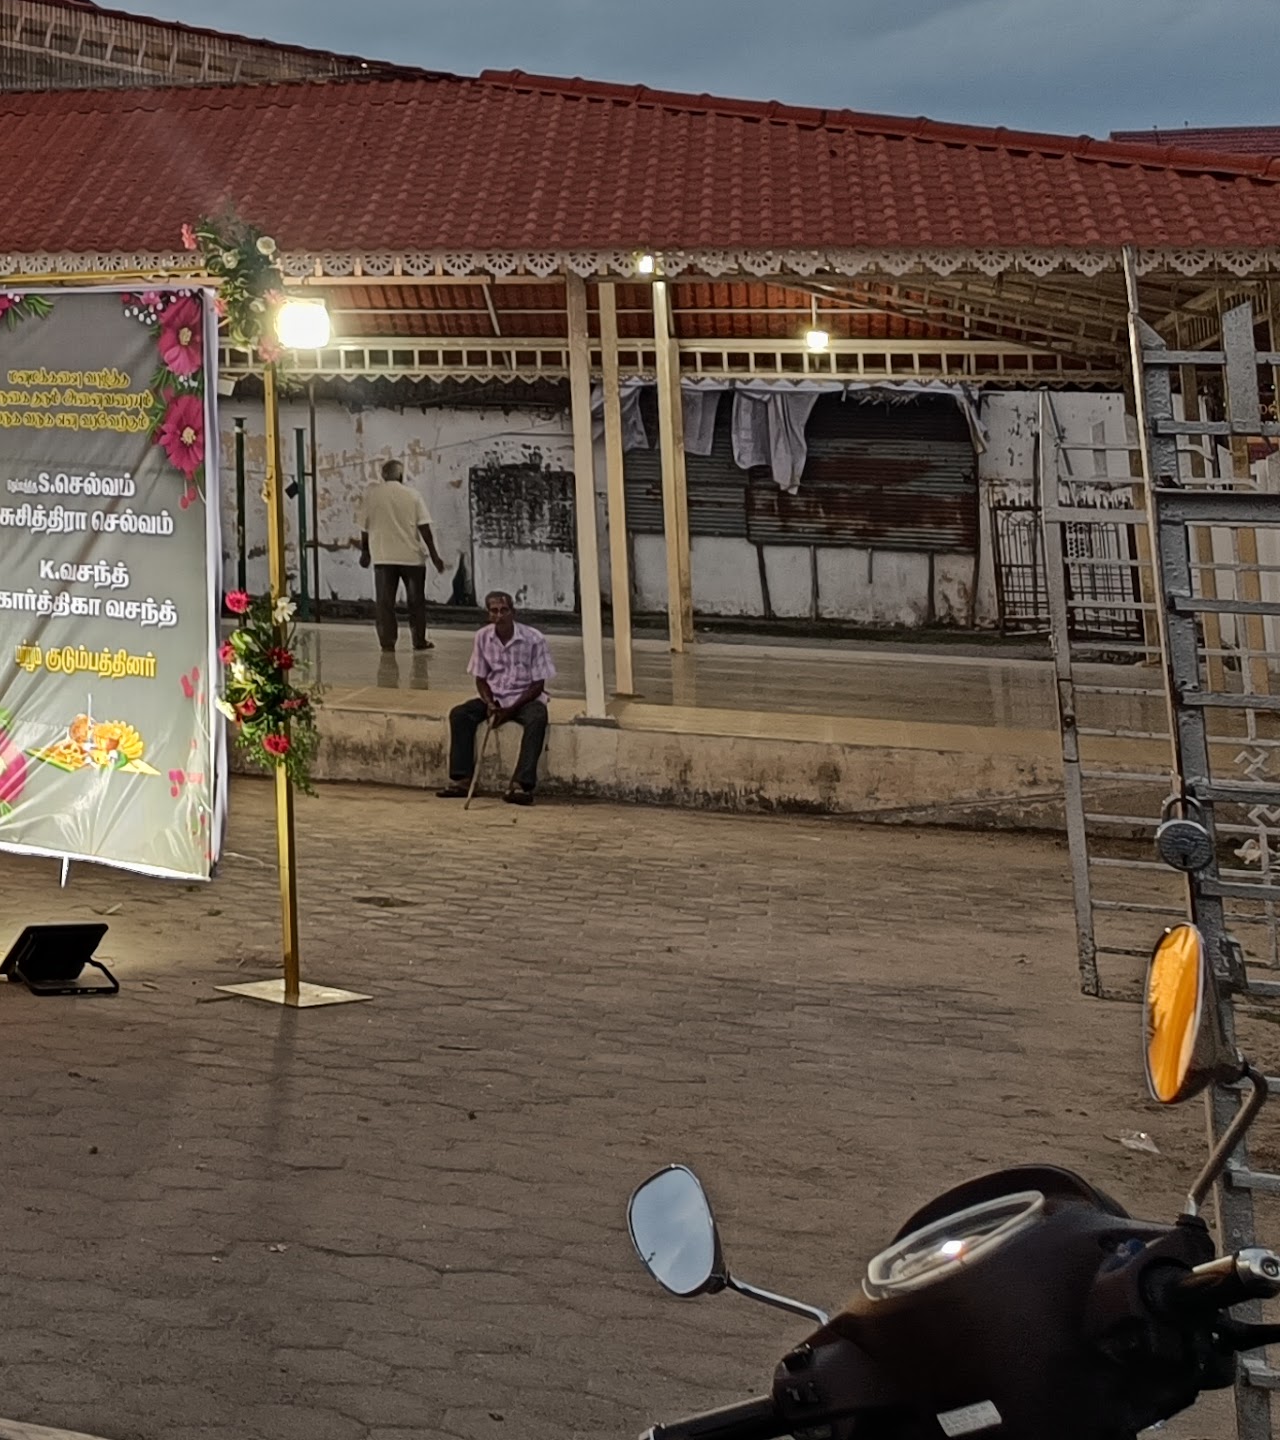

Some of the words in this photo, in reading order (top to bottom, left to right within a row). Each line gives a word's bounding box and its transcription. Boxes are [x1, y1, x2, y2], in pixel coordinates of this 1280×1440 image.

[38, 471, 136, 497] S.செல்வம்
[91, 508, 174, 535] செல்வம்
[40, 559, 130, 590] K.வசந்த்
[106, 597, 178, 629] வசந்த்
[45, 644, 156, 678] குடும்பத்தினர்
